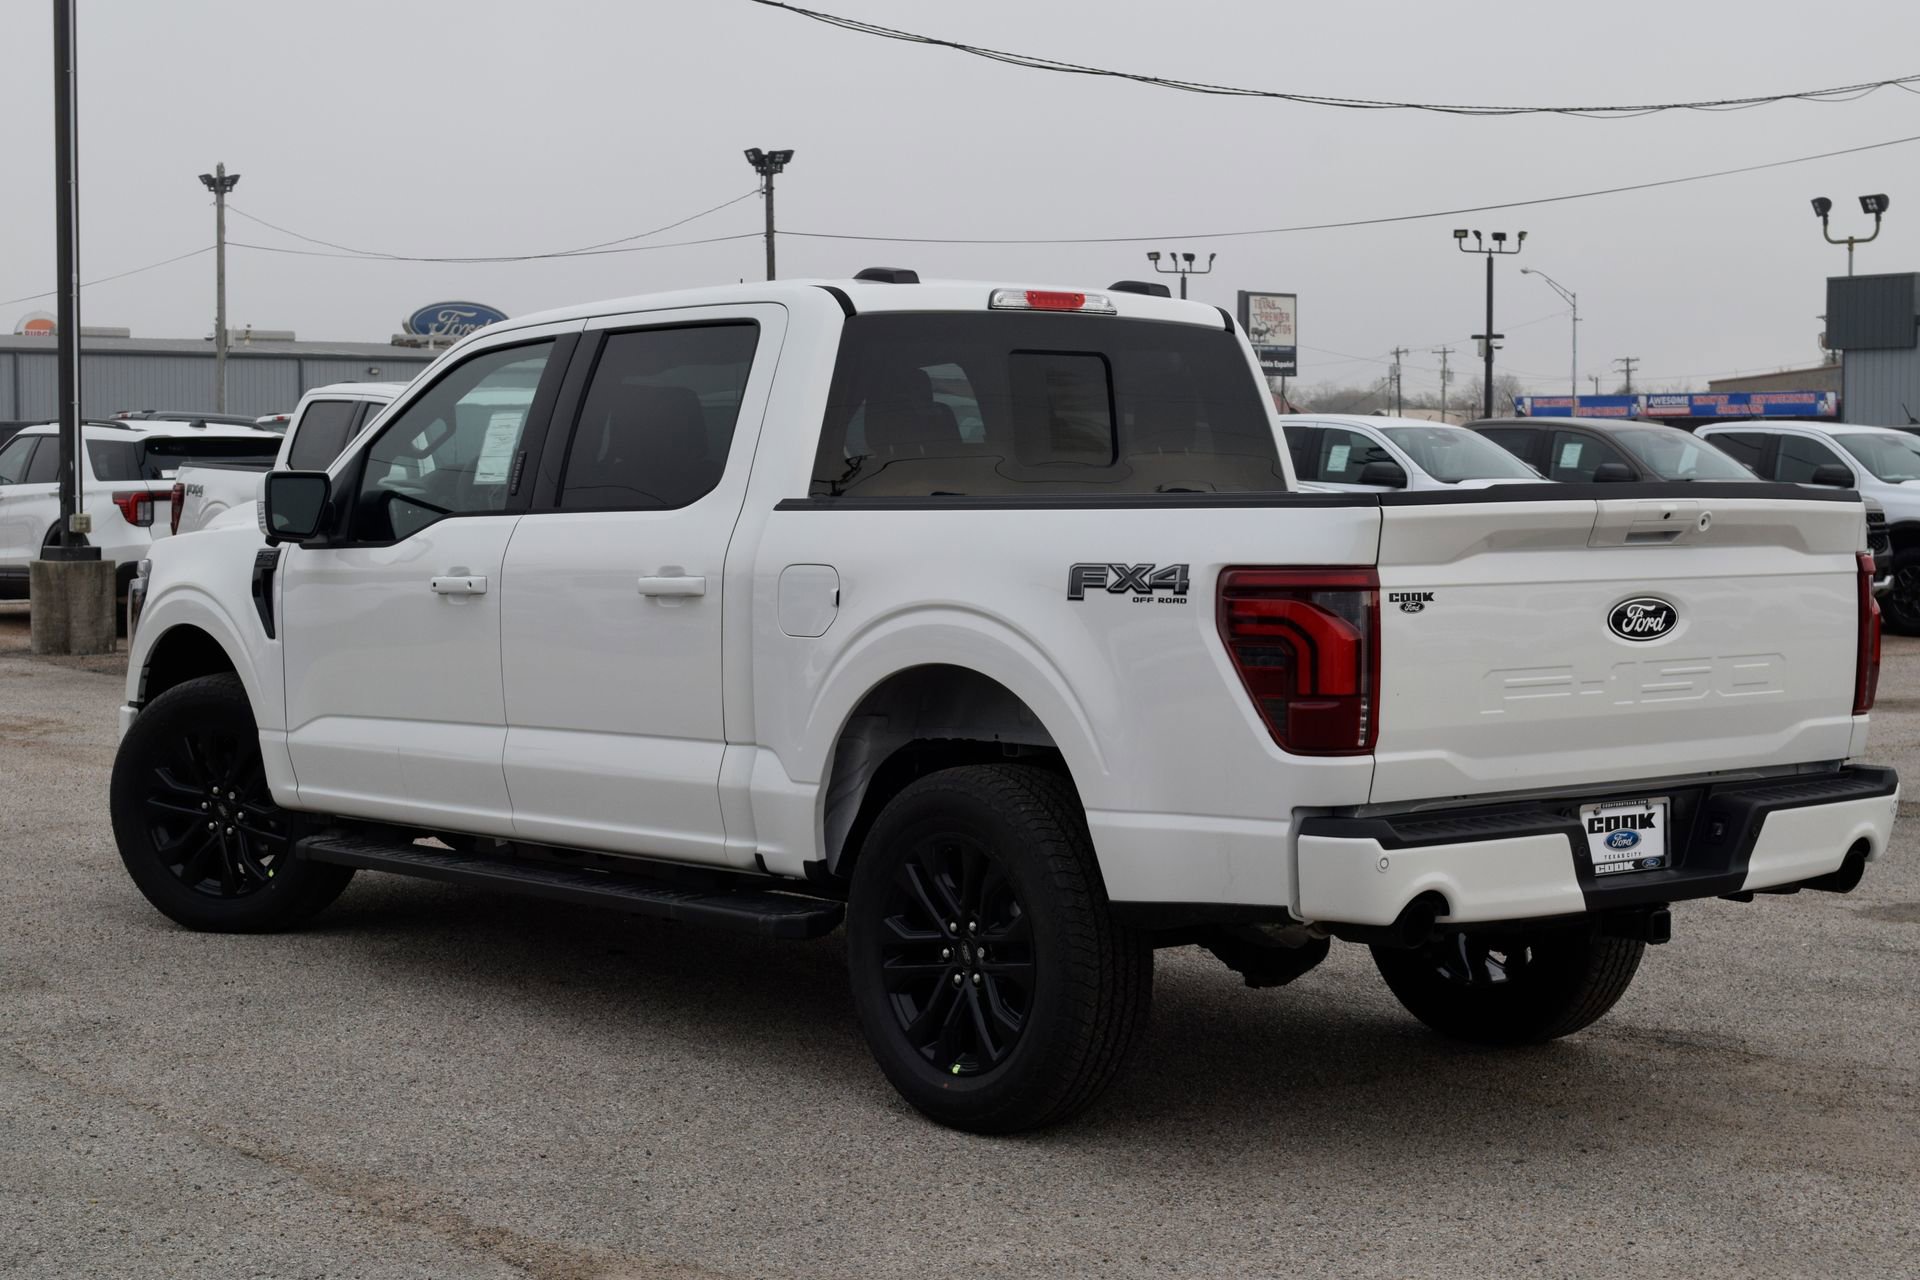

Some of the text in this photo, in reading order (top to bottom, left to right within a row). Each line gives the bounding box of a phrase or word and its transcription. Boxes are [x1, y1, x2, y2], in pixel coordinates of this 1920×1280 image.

[1067, 563, 1190, 601] FX4
[1132, 596, 1187, 604] OFF ROAD
[1389, 592, 1435, 603] COOK
[1621, 603, 1666, 634] Ford
[1588, 812, 1656, 834] COOK
[1611, 832, 1634, 848] Ford
[1604, 852, 1625, 860] TEXAS
[1595, 861, 1636, 874] COOK
